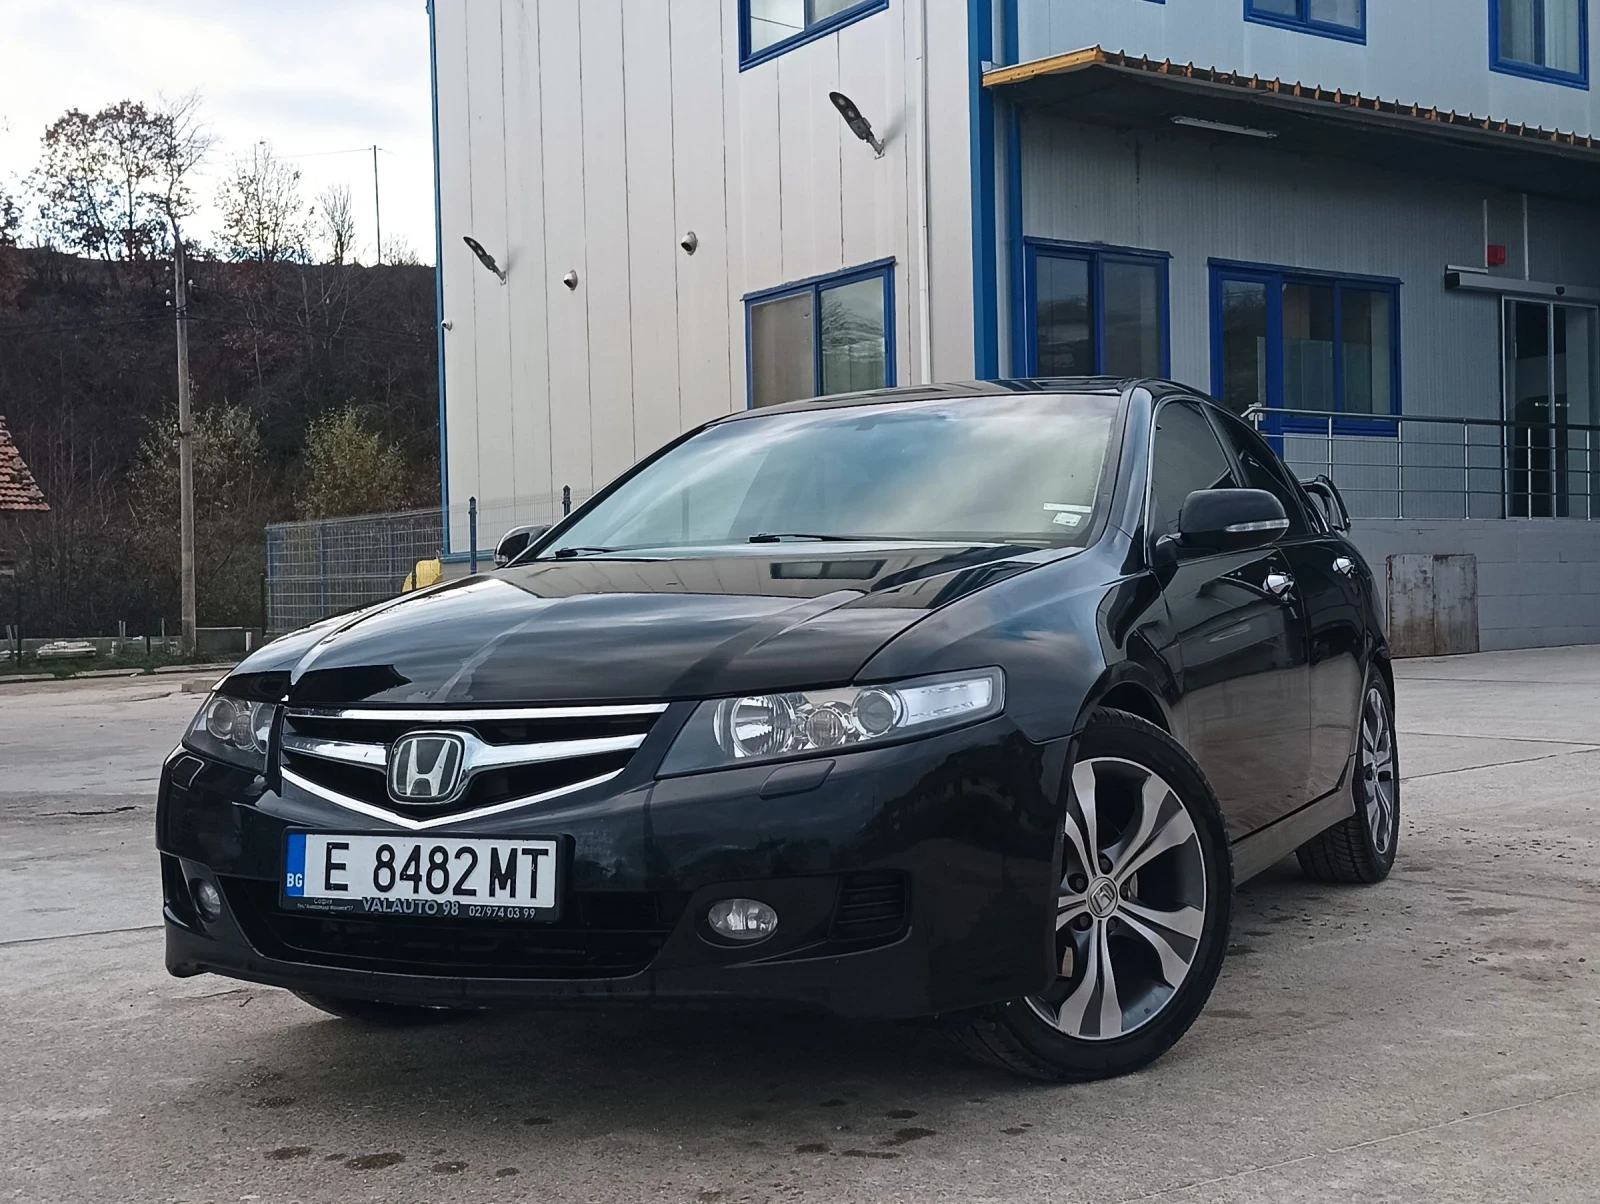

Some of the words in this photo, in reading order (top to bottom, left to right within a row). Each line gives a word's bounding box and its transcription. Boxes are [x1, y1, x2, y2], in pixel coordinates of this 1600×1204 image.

[286, 873, 304, 888] BG
[324, 841, 350, 892] E
[372, 843, 480, 897] 8482
[488, 846, 550, 900] MT
[362, 897, 438, 915] VALAUTO
[442, 901, 460, 916] 98
[468, 905, 505, 918] 02/974
[507, 908, 520, 919] 03
[523, 908, 536, 919] 99
